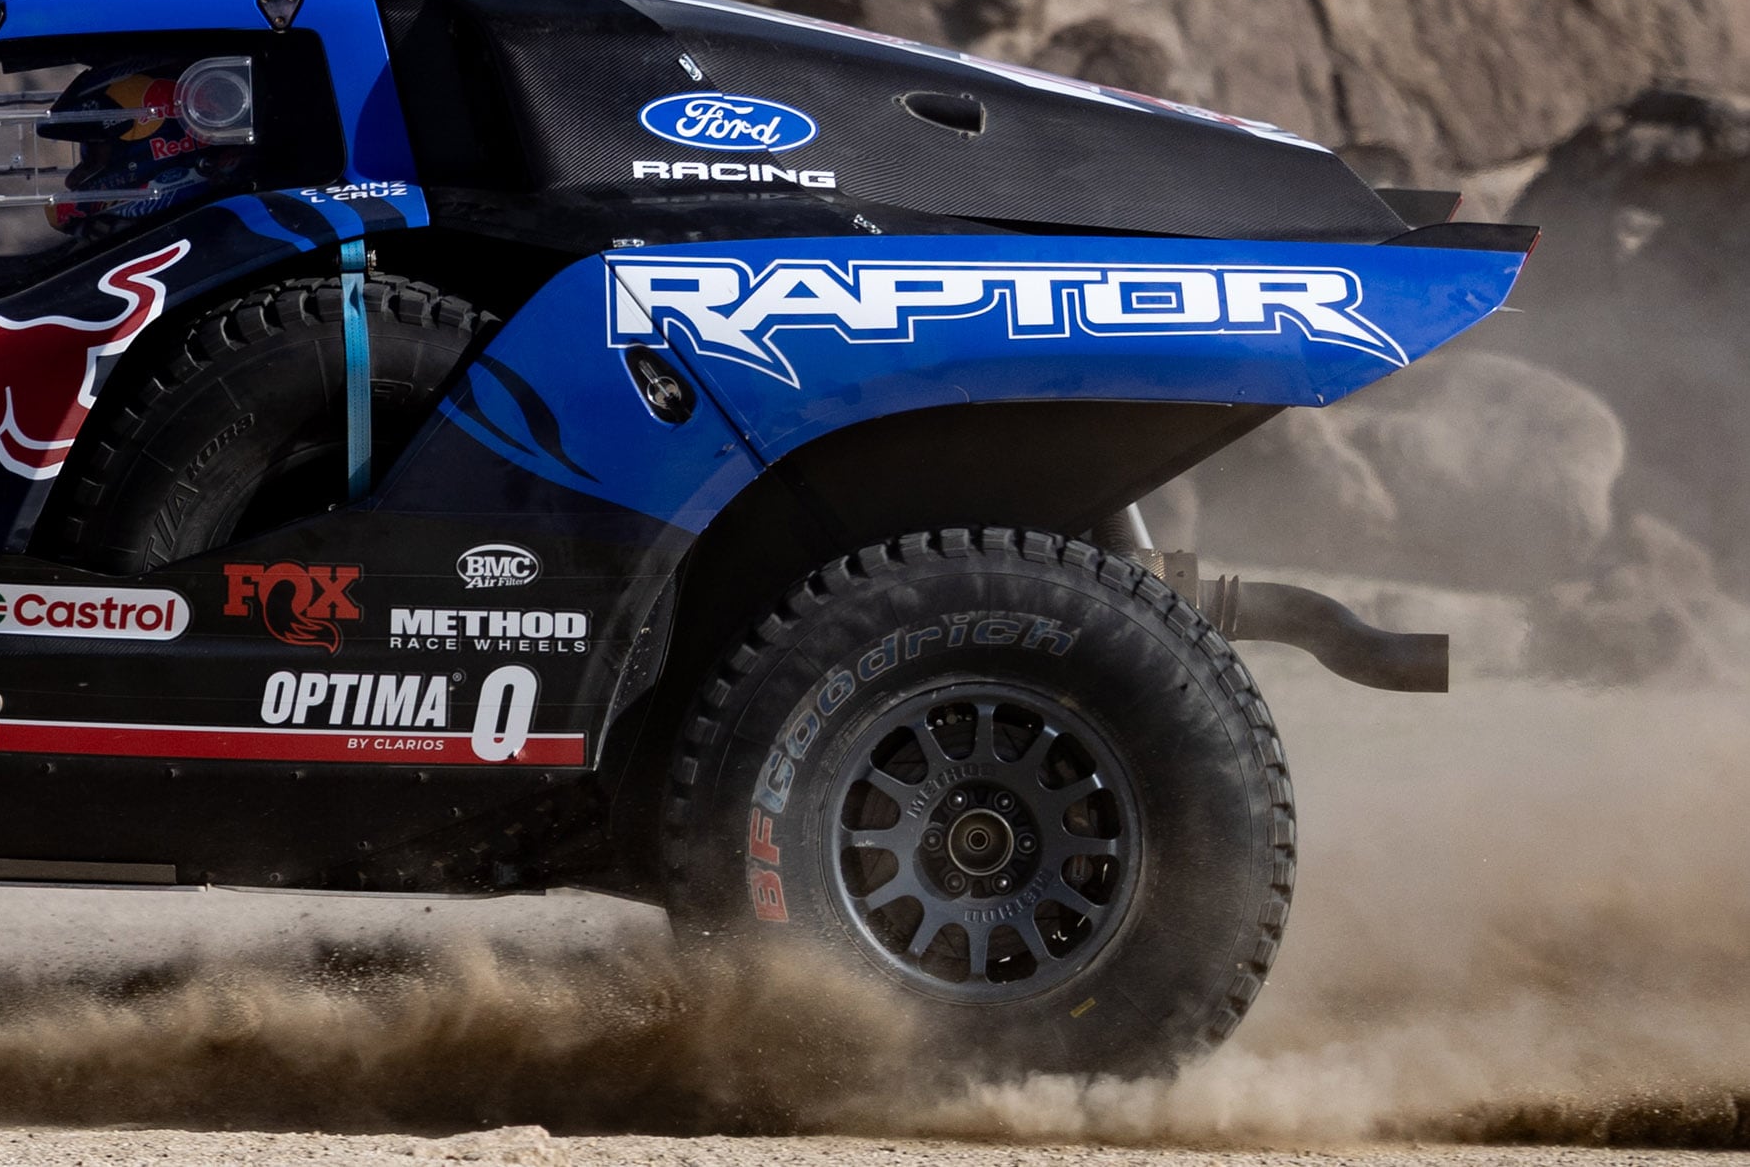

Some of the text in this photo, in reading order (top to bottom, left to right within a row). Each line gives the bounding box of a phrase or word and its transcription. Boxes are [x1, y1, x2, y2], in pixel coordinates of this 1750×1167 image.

[675, 99, 782, 145] Ford
[149, 134, 196, 161] Red
[325, 179, 408, 195] SAINZ
[632, 160, 836, 189] RACING
[332, 187, 408, 201] CRUZ
[608, 258, 1405, 384] RAPTOR
[464, 555, 532, 578] BMC
[464, 576, 525, 590] Air Filter
[223, 562, 360, 634] FOX
[13, 593, 177, 632] Castrol
[390, 608, 587, 639] METHOD
[389, 637, 587, 653] RACE WHEELS
[346, 738, 445, 752] BY CLARIOS
